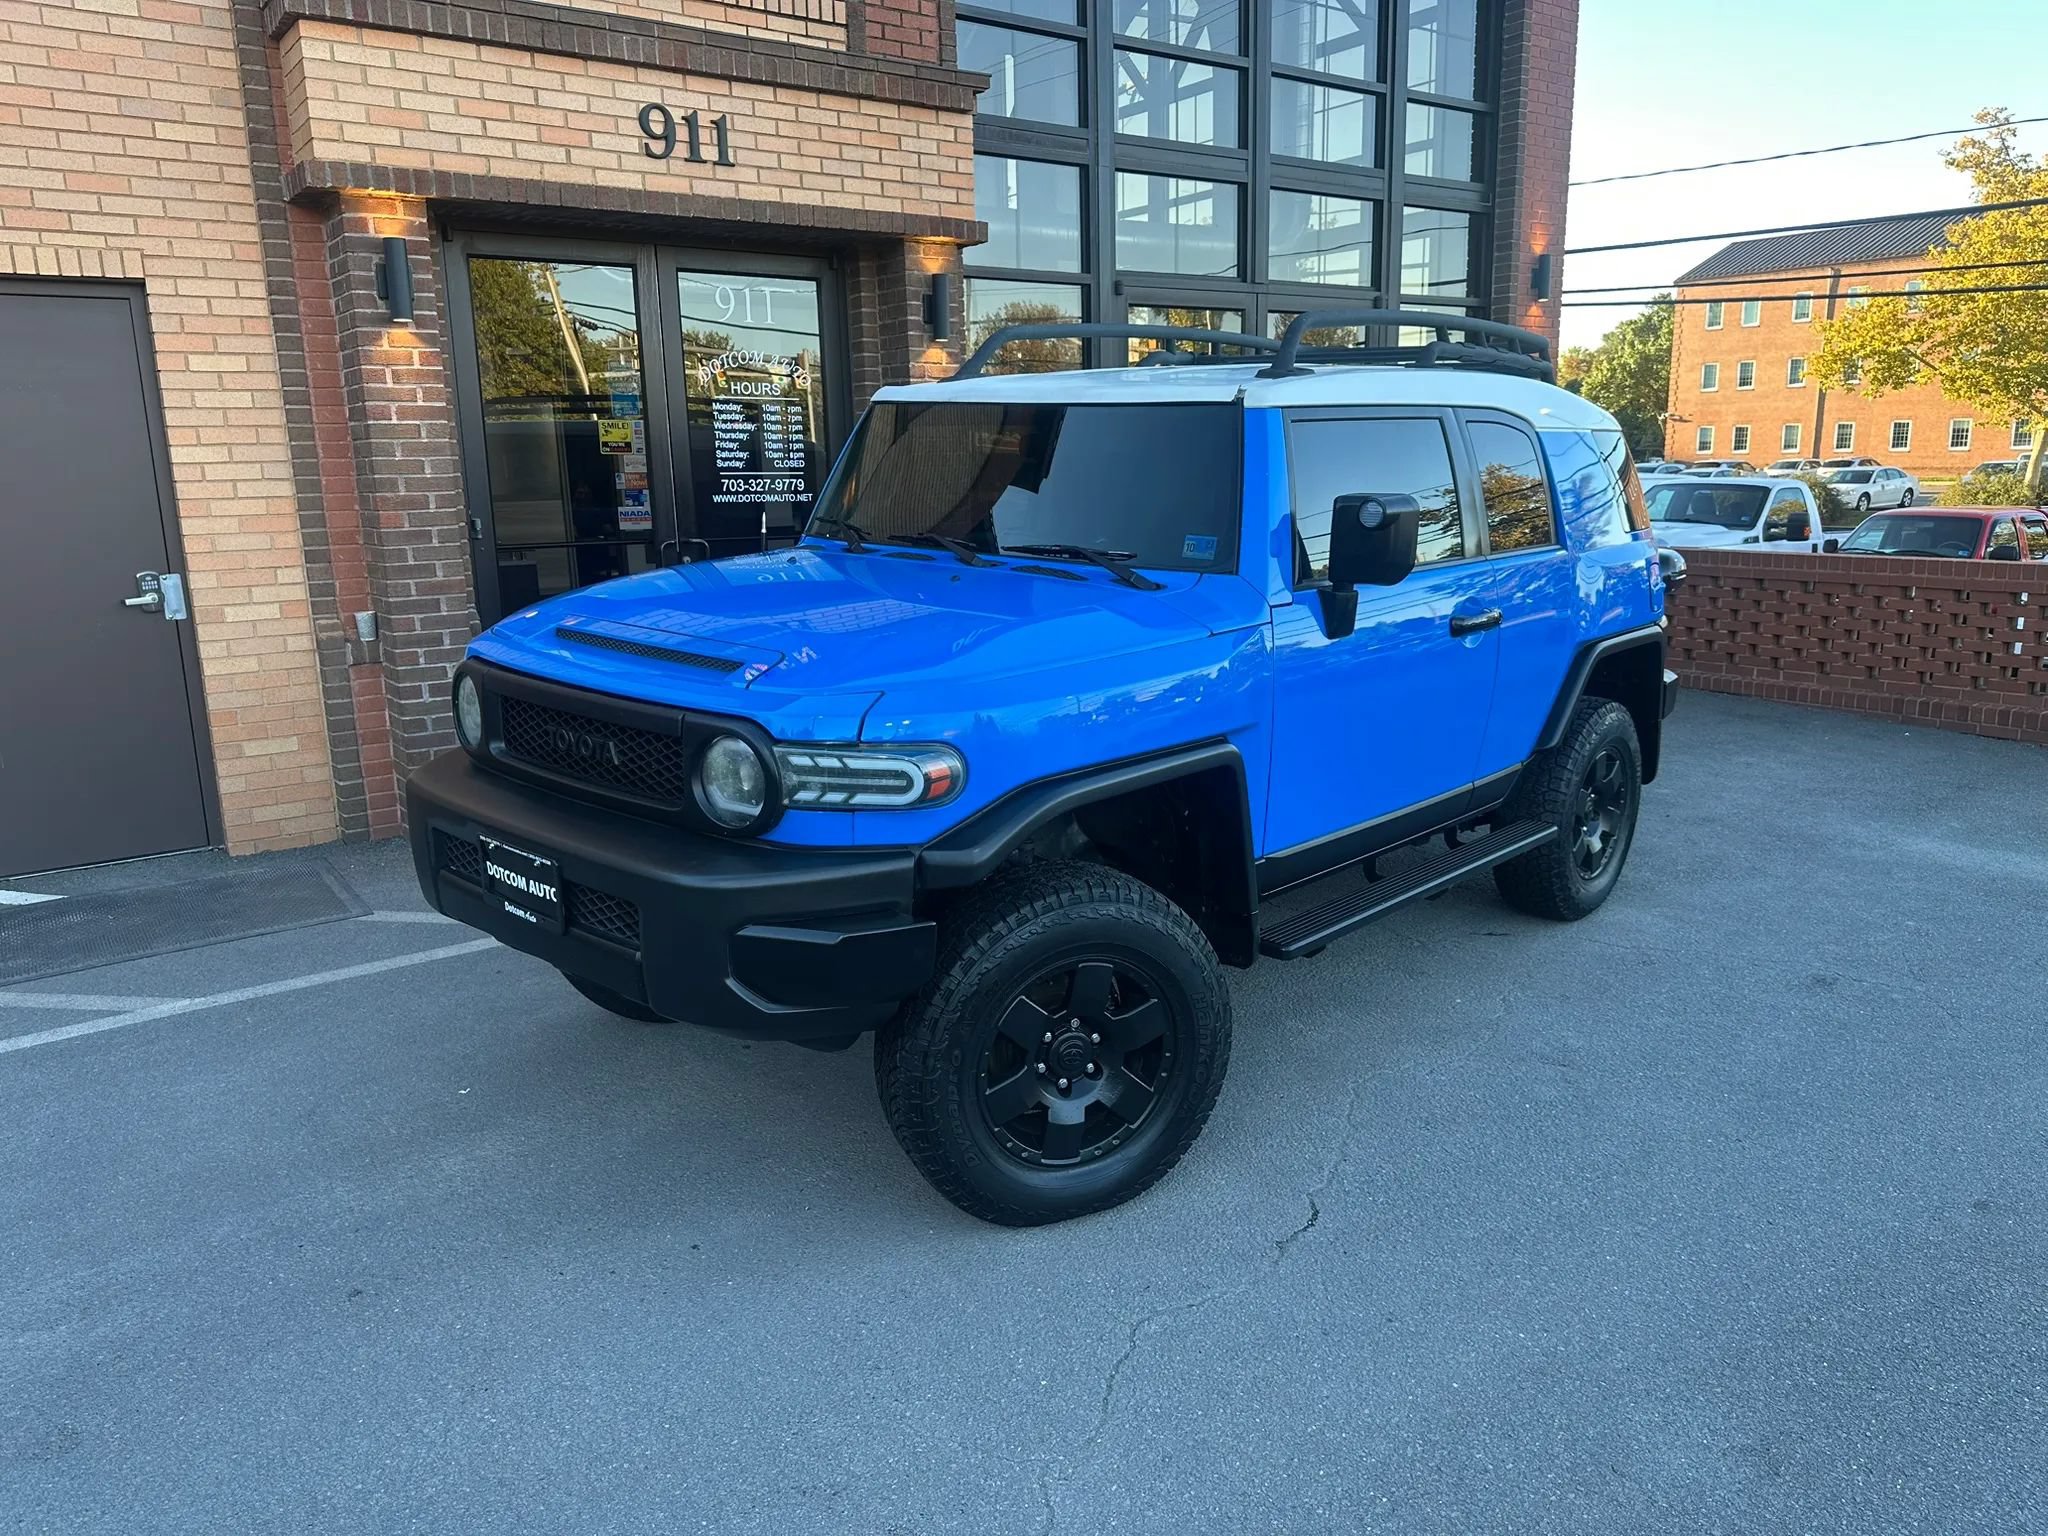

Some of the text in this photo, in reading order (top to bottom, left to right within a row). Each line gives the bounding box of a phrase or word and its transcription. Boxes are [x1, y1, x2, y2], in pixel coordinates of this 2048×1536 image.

[638, 102, 736, 168] 911
[715, 286, 775, 324] 911
[699, 350, 812, 387] DOTCOM AUTO
[730, 382, 781, 396] HOURS
[712, 402, 743, 412] Monday:
[762, 404, 781, 412] 10am
[713, 411, 746, 421] Tuesday:
[601, 422, 629, 430] SMILE!
[713, 421, 758, 431] Wednesday:
[763, 423, 782, 431] 10am
[714, 431, 749, 441] Thursday:
[715, 440, 740, 450] Friday:
[715, 450, 750, 459] Saturday:
[716, 459, 805, 468] Sunday: CLOSED
[720, 479, 805, 492] 703-327-9779
[712, 493, 813, 503] WWW.DOTCOMAUTO.NET
[620, 510, 651, 518] NIADA
[486, 860, 527, 892] DOTCOM
